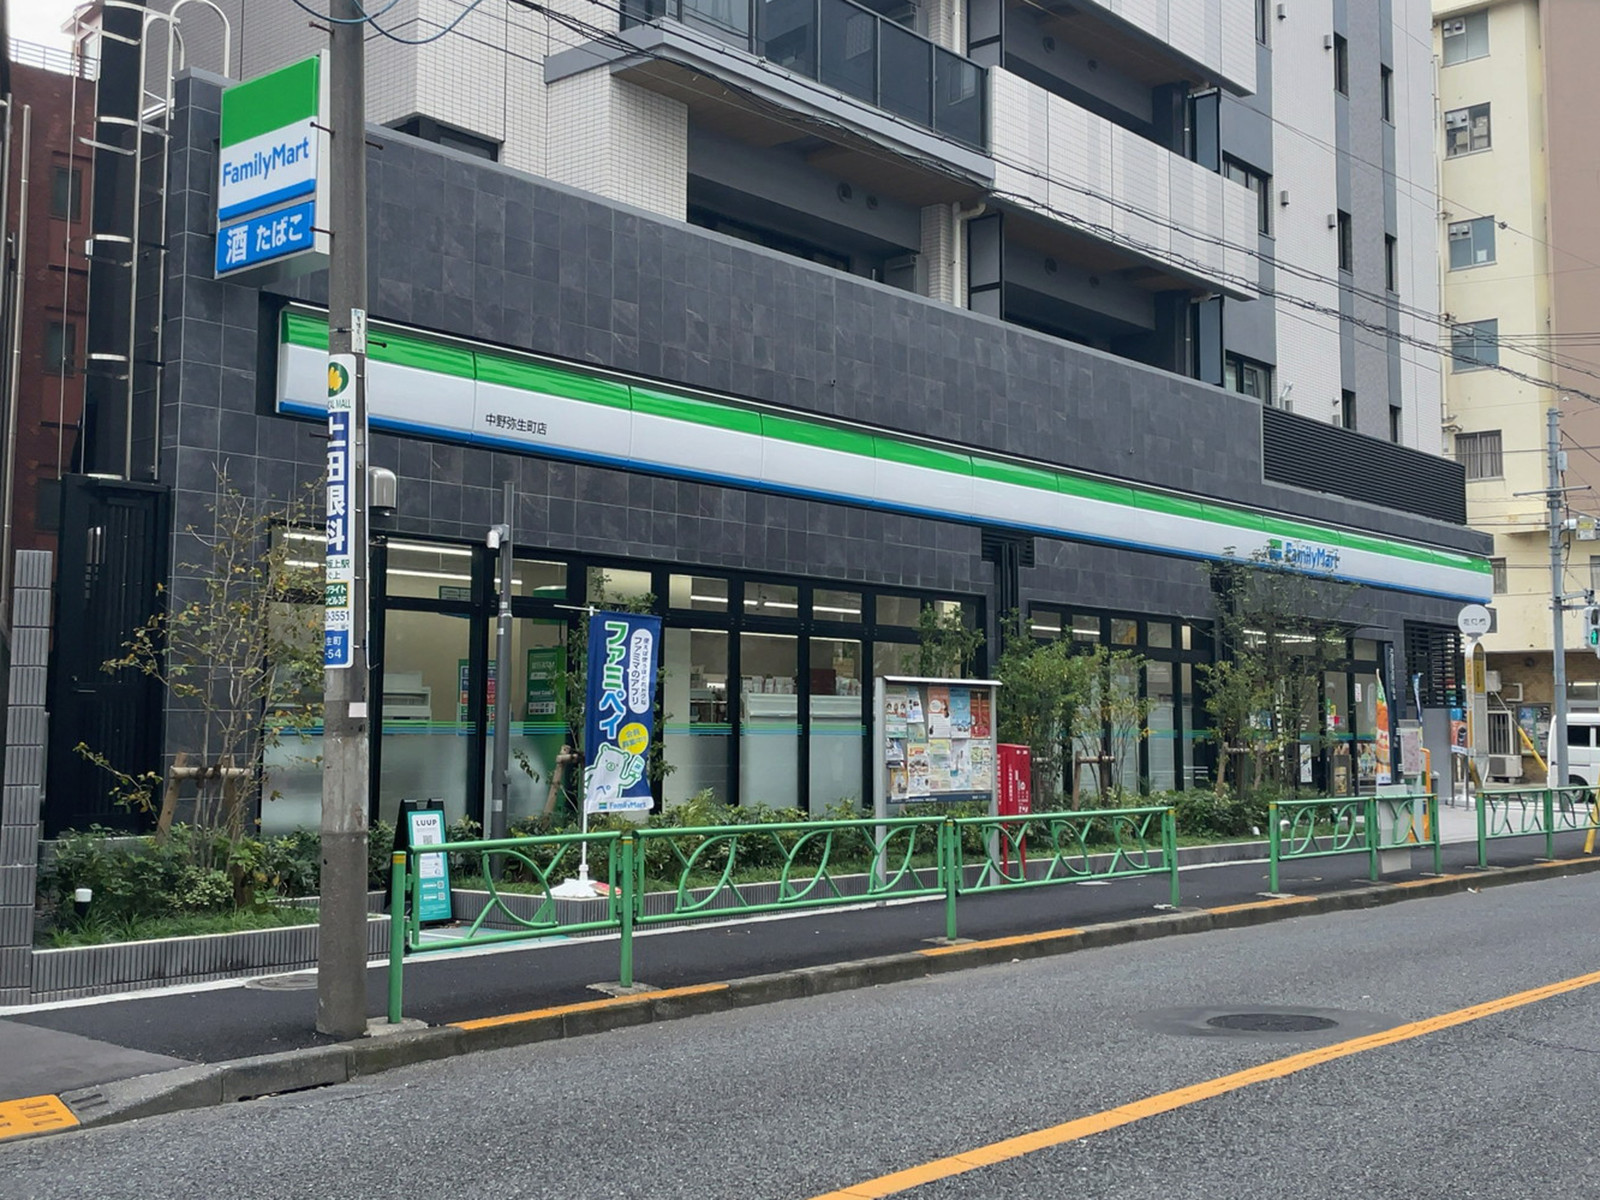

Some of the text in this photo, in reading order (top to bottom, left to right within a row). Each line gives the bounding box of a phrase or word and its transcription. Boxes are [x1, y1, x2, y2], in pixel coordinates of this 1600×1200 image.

[222, 137, 309, 187] FamilyMart
[226, 213, 304, 264] 酒 たばこ
[485, 413, 548, 435] 中野弥生町店
[599, 620, 629, 739] ファミペイ
[416, 819, 438, 827] LUUP
